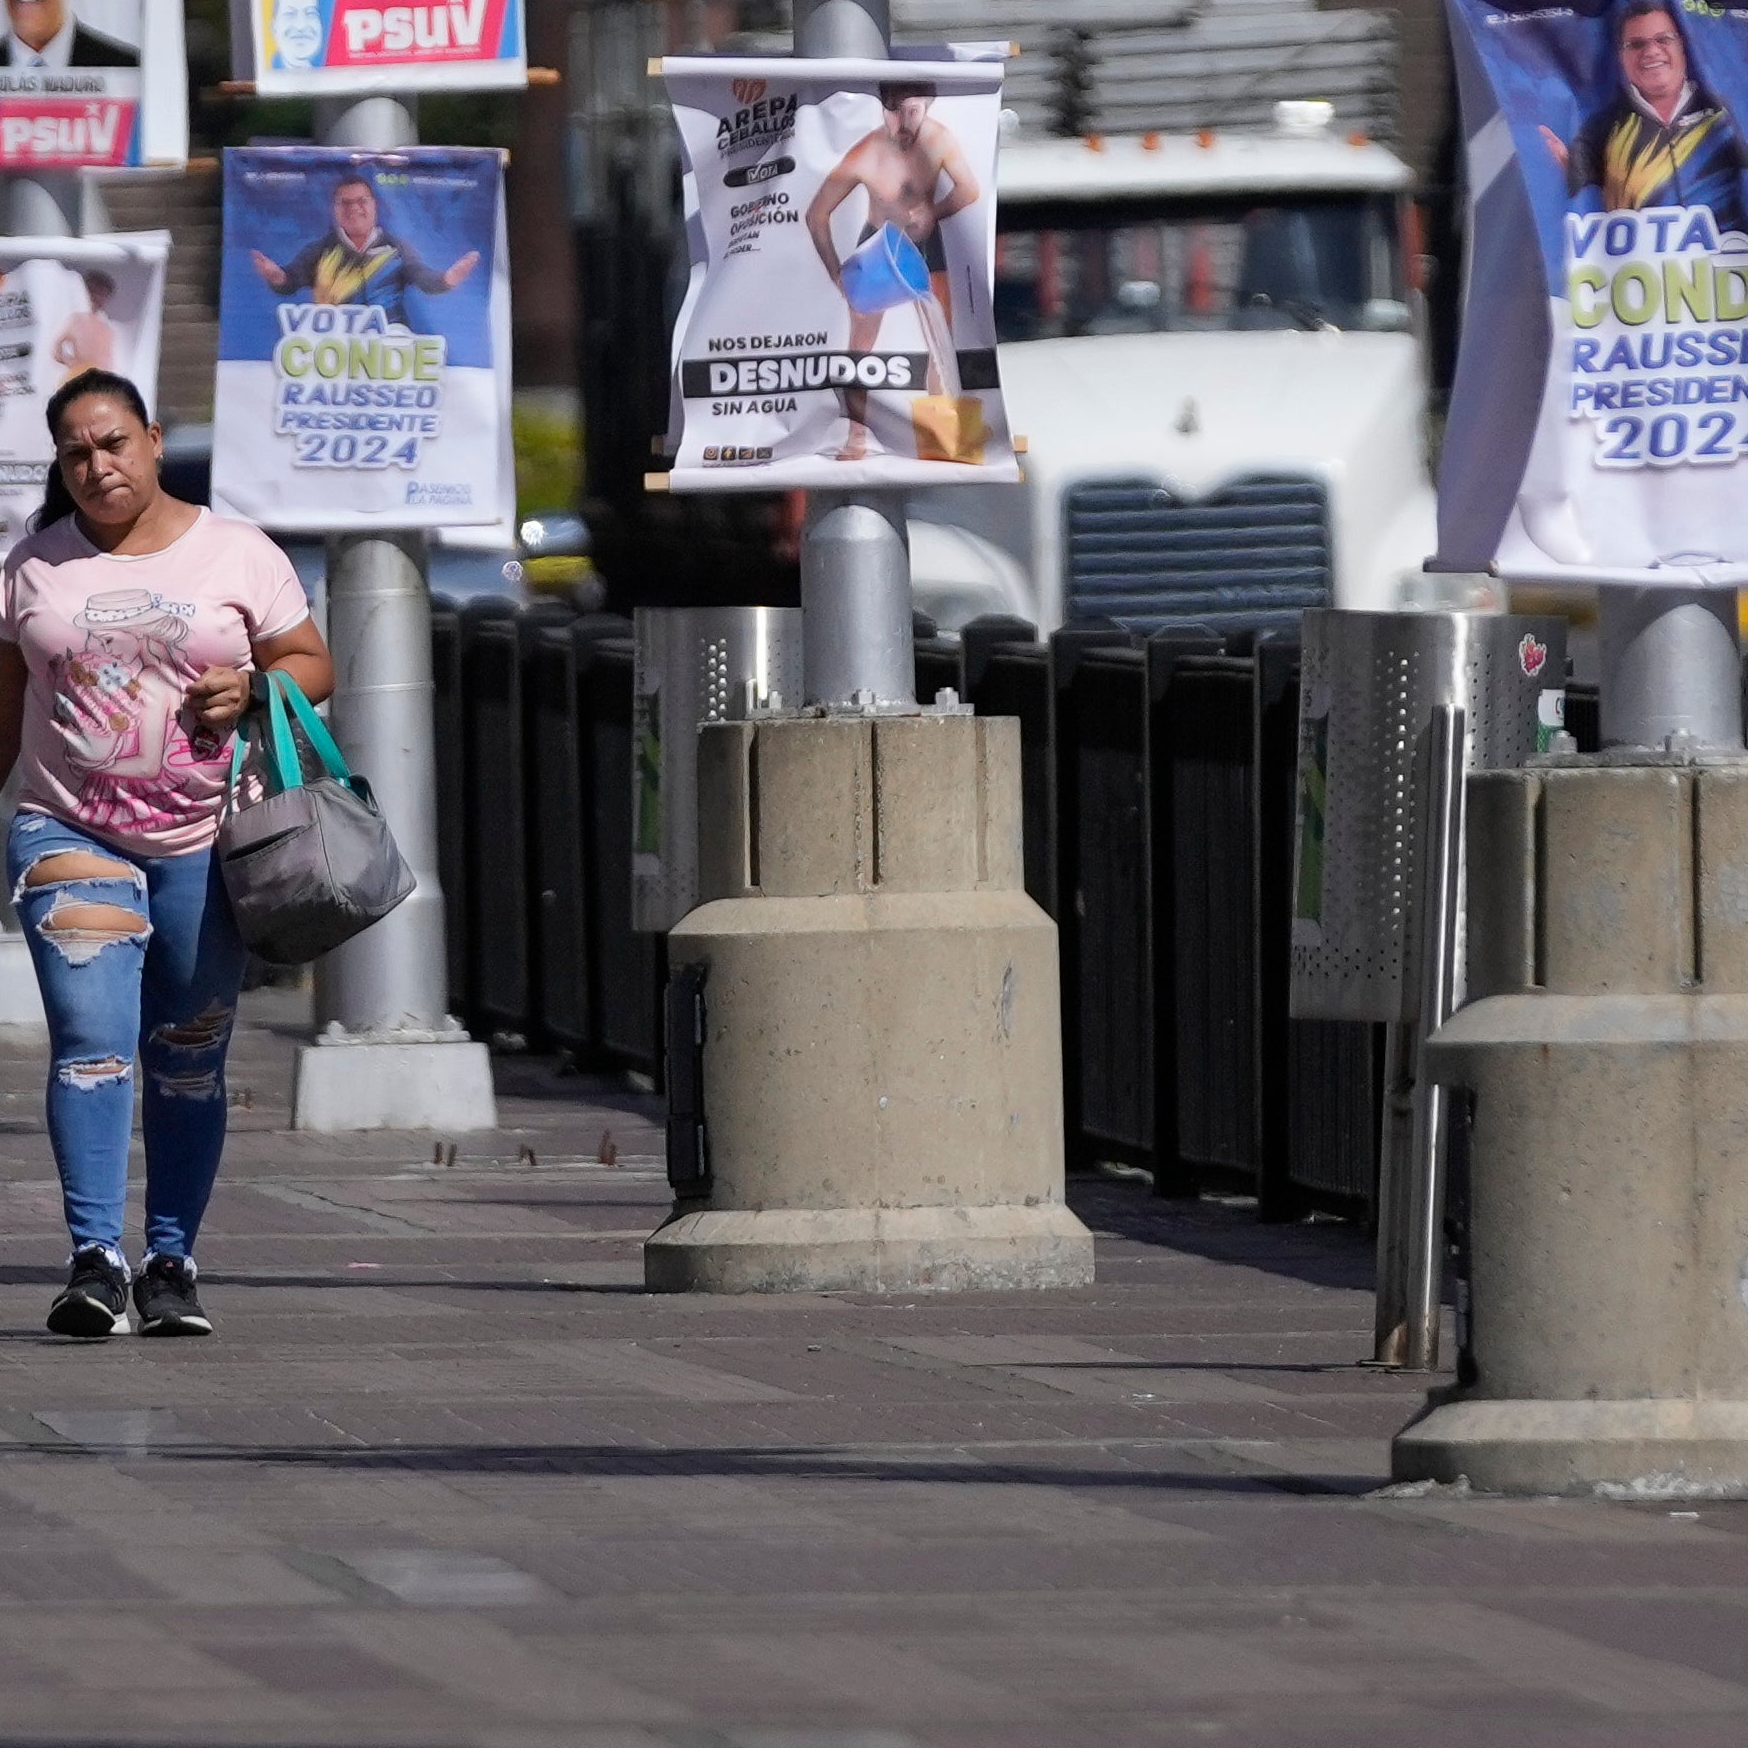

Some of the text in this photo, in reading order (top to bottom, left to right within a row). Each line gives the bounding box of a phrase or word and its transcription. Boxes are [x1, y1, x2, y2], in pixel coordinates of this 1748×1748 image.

[716, 93, 798, 139] AREPA
[717, 112, 797, 151] CEBALLOS
[1568, 211, 1718, 259] VOTA
[284, 307, 386, 335] VOTA
[709, 331, 828, 352] NOS DEJARON
[281, 336, 440, 382] CONDE
[709, 355, 912, 395] DESNUDOS
[282, 383, 438, 409] RAUSSEO
[712, 397, 798, 416] SIN AGUA
[281, 411, 439, 433] PRESIDENTE
[300, 433, 420, 464] 2024
